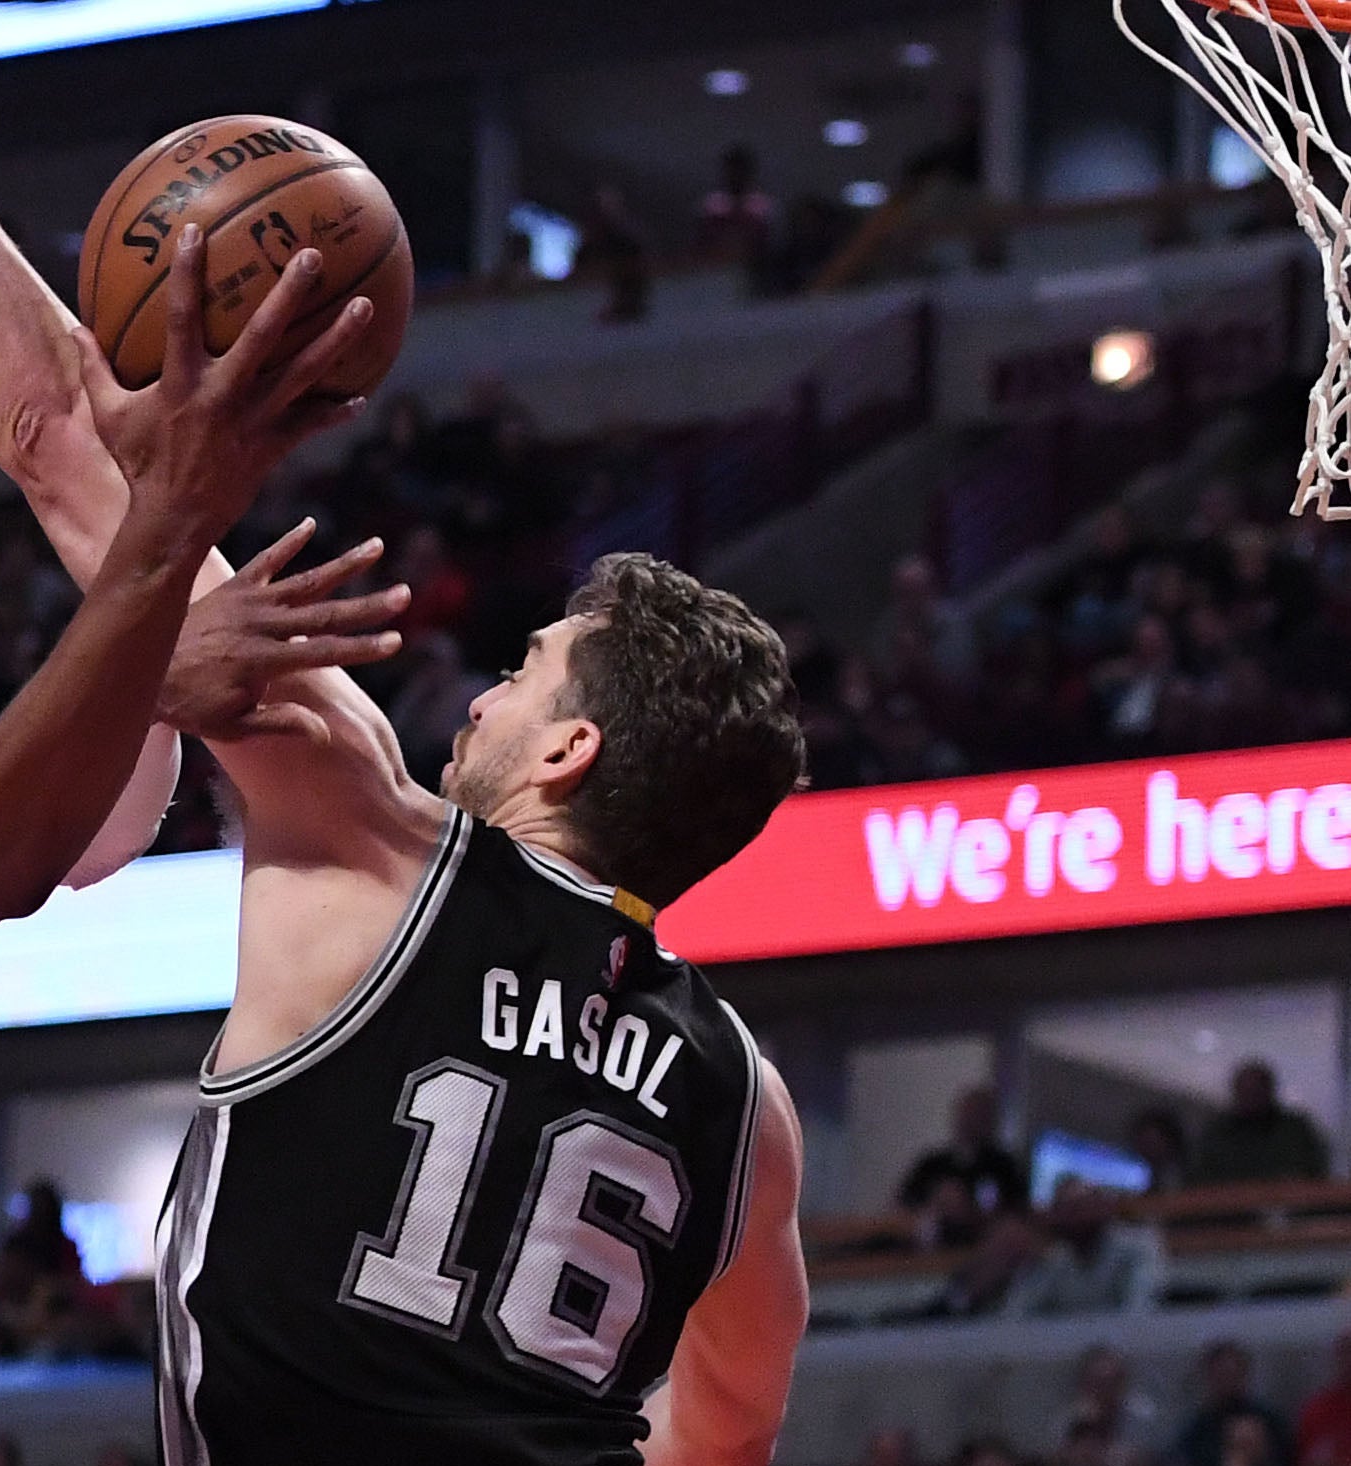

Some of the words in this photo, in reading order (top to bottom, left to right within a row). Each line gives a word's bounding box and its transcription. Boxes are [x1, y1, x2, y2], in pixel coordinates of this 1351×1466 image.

[123, 128, 326, 265] SPALDING
[863, 782, 1124, 911] We're
[1145, 769, 1351, 887] here
[481, 966, 684, 1119] GASOL
[337, 1056, 692, 1399] 16
